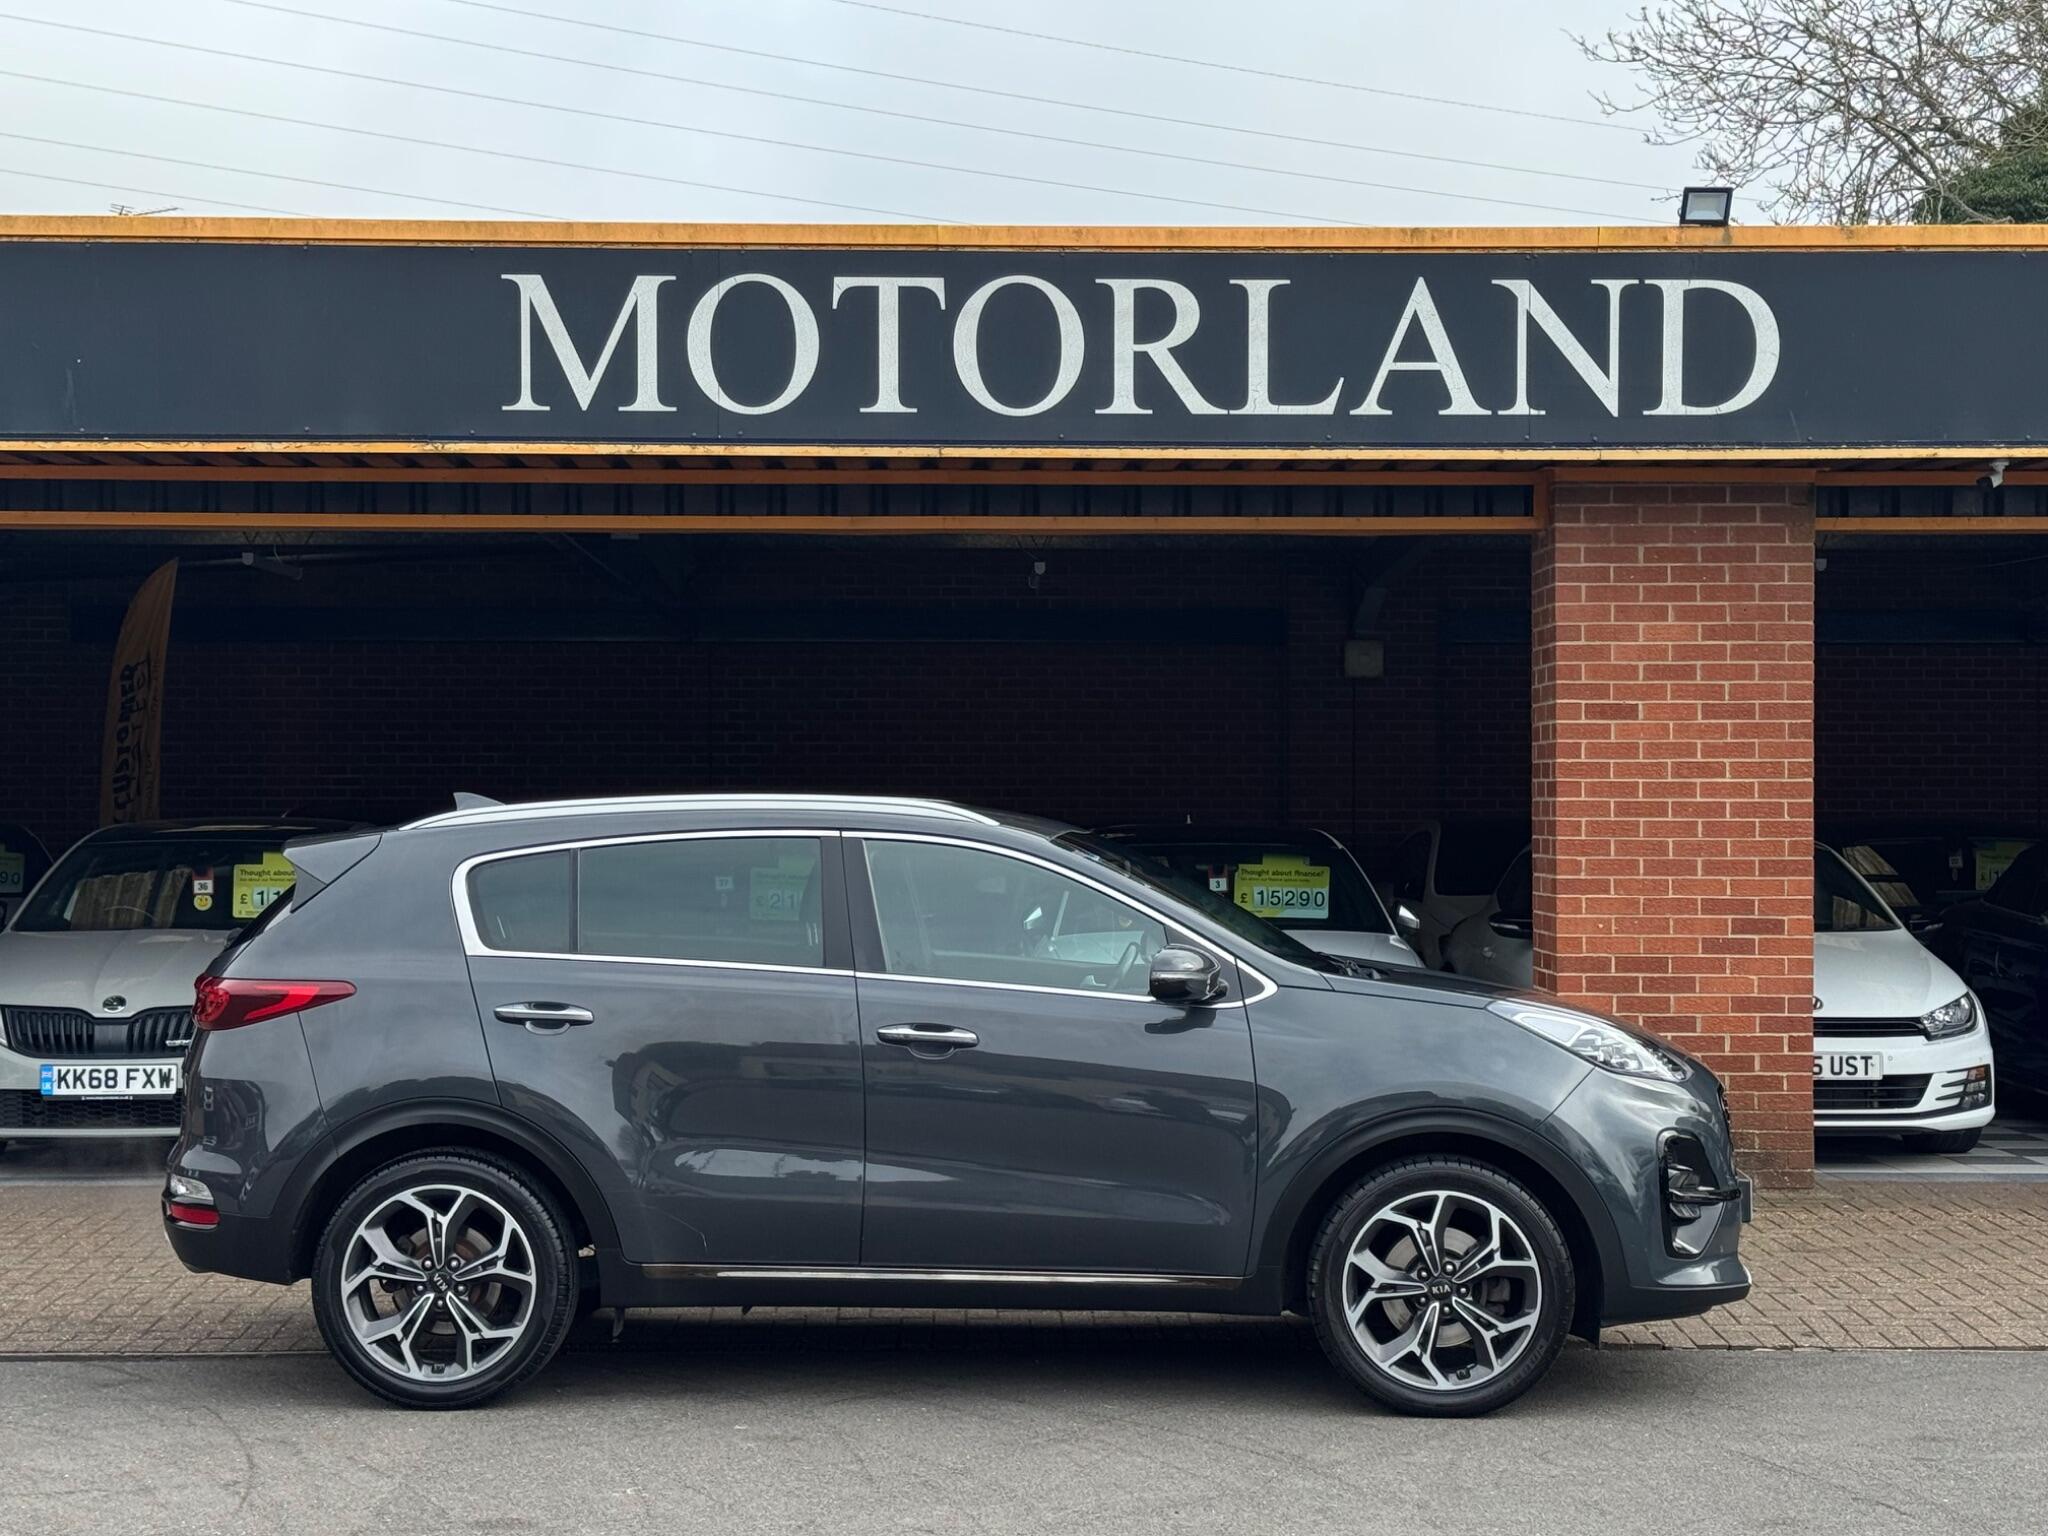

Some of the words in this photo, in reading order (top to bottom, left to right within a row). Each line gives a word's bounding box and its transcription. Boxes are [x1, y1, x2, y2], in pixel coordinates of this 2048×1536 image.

[501, 273, 1781, 418] MOTORLAND
[240, 869, 271, 878] Thought
[273, 869, 295, 877] about
[1241, 868, 1269, 877] Thought
[1271, 869, 1292, 877] about
[1294, 869, 1325, 877] finance?
[198, 882, 209, 891] 36
[1215, 880, 1221, 889] 3
[240, 893, 248, 904] £
[1240, 892, 1248, 904] £
[1257, 890, 1325, 907] 15290
[1830, 1055, 1873, 1076] UST
[57, 1068, 118, 1089] KK68
[125, 1068, 172, 1089] FXW
[433, 1273, 448, 1291] KIA
[1431, 1284, 1451, 1295] KIA
